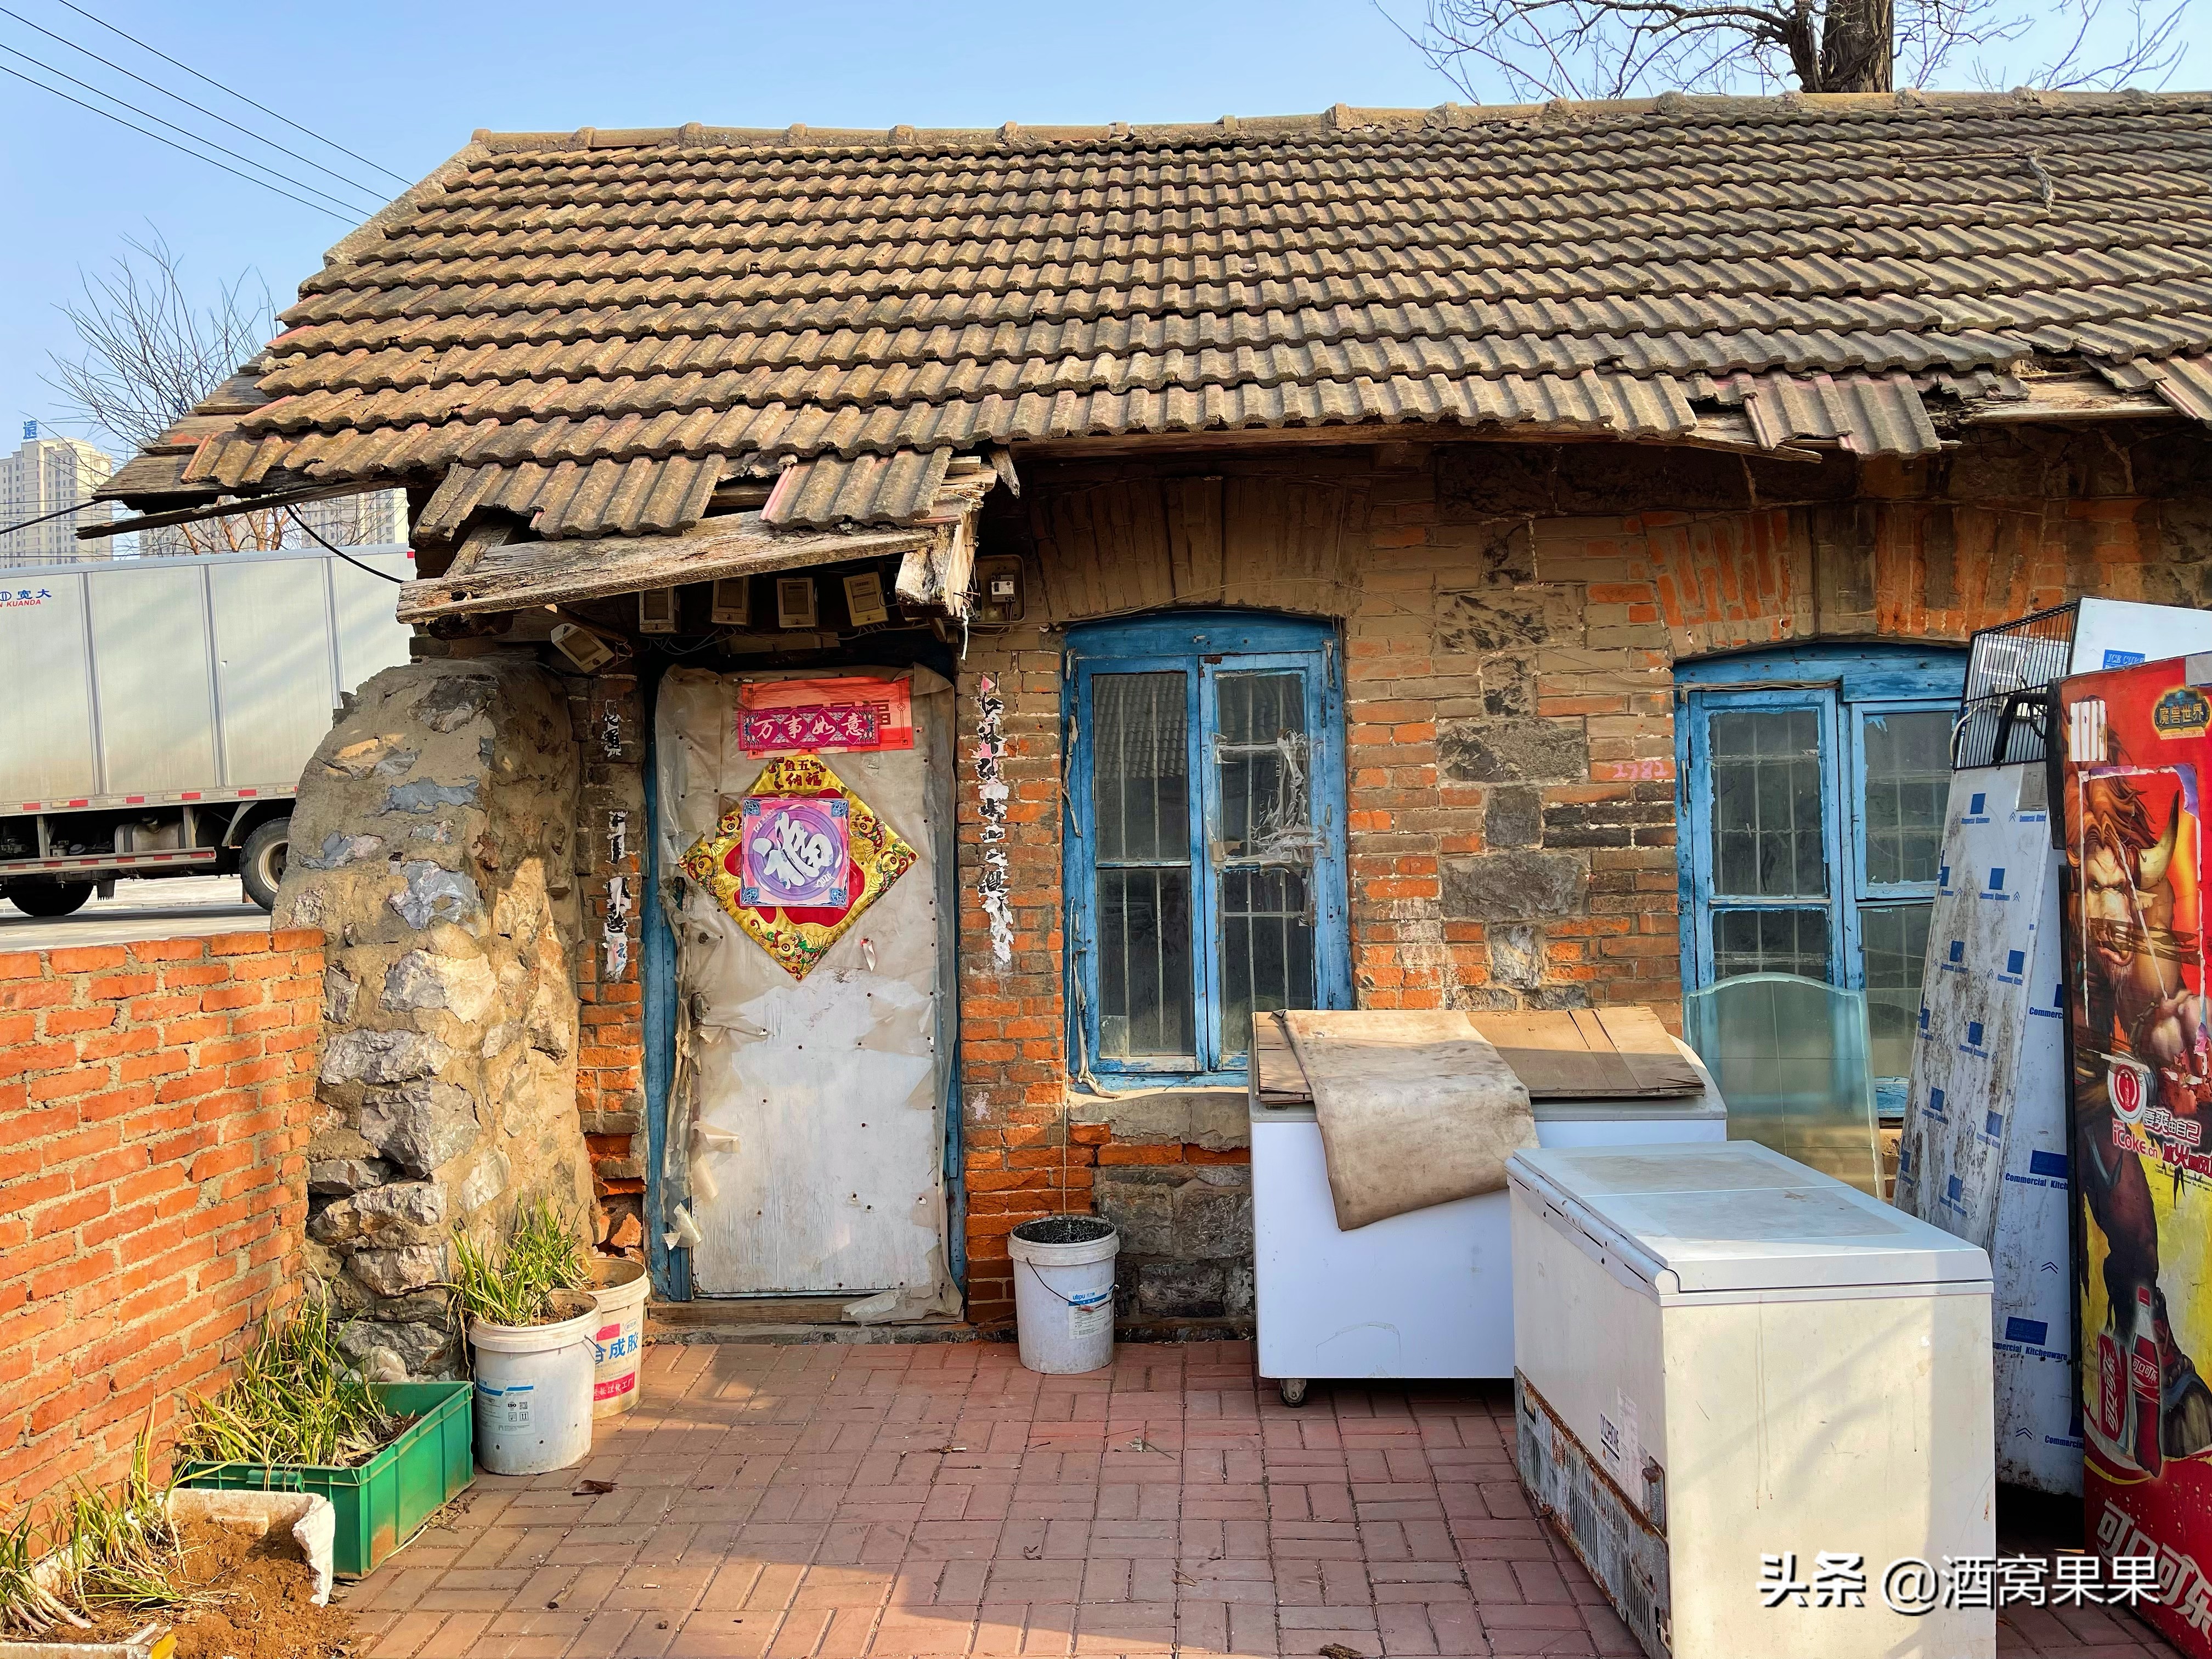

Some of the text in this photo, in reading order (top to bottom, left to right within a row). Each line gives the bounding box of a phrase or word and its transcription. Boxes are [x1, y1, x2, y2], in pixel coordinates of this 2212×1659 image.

[16, 589, 52, 600] 宽大
[7, 599, 41, 607] KUANDA
[2159, 703, 2204, 724] 魔兽世界
[754, 712, 865, 739] 万事如意
[2029, 1007, 2063, 1019] Commerc
[2005, 1173, 2047, 1187] Commercial
[2025, 1346, 2068, 1361] Kitchenware
[2132, 1358, 2159, 1382] 可口可乐
